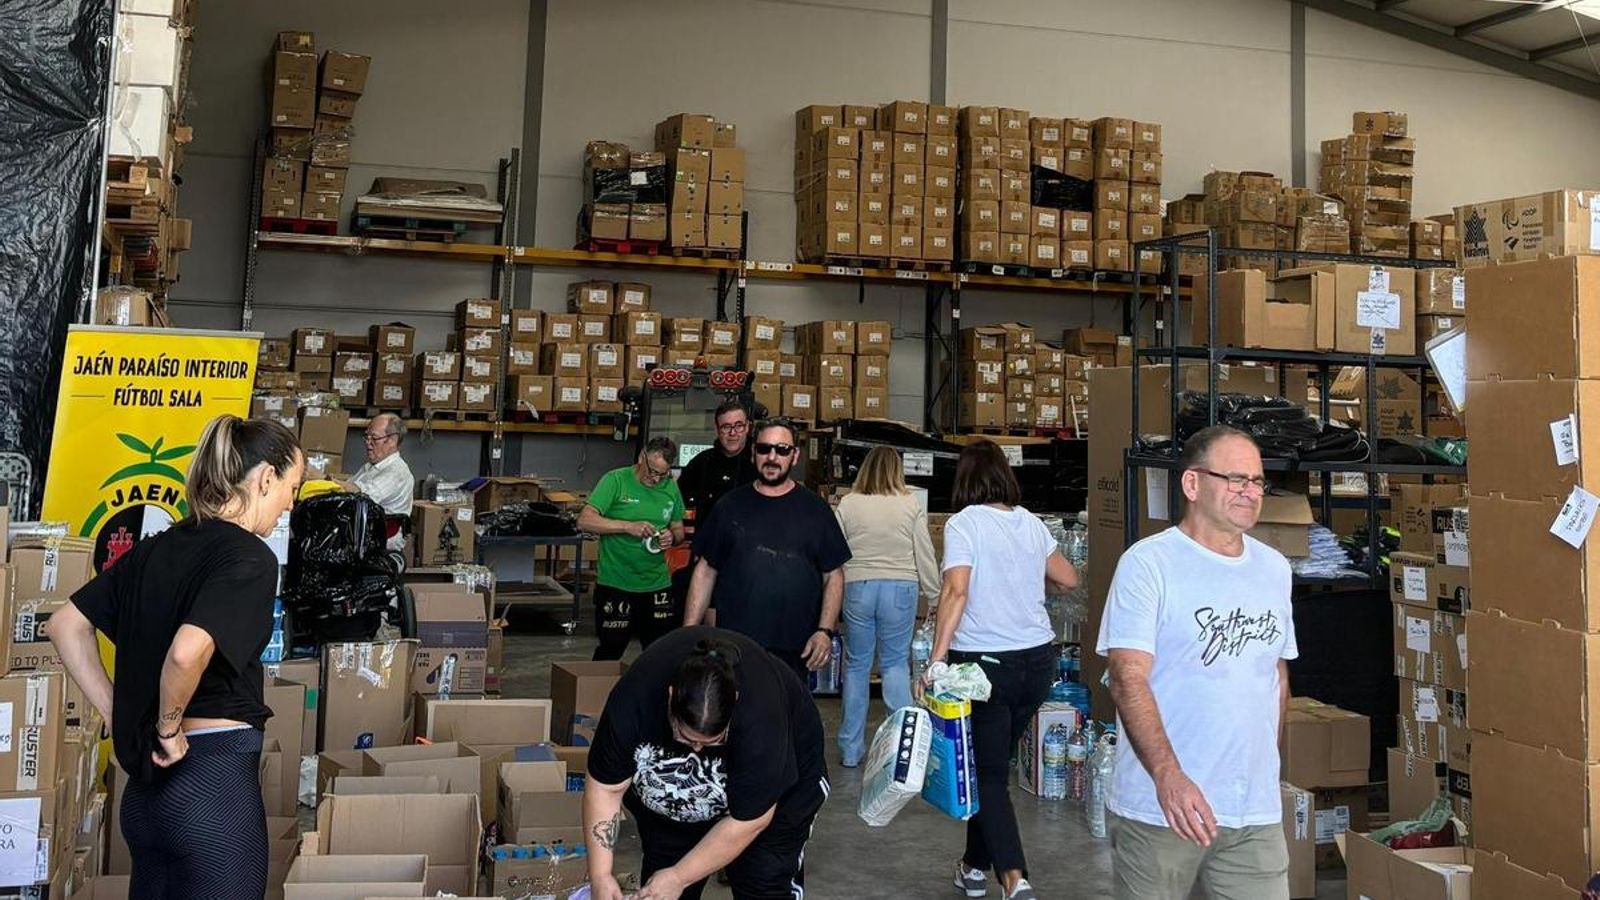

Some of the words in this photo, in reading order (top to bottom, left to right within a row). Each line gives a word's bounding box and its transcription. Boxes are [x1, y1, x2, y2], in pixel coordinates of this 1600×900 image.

[73, 351, 113, 376] JAÉN
[118, 353, 179, 377] PARAÍSO
[184, 359, 248, 379] INTERIOR
[113, 383, 164, 406] FÚTBOL
[169, 390, 202, 407] SALA
[111, 484, 179, 508] JAEN
[1200, 627, 1282, 667] District
[25, 656, 39, 666] TO
